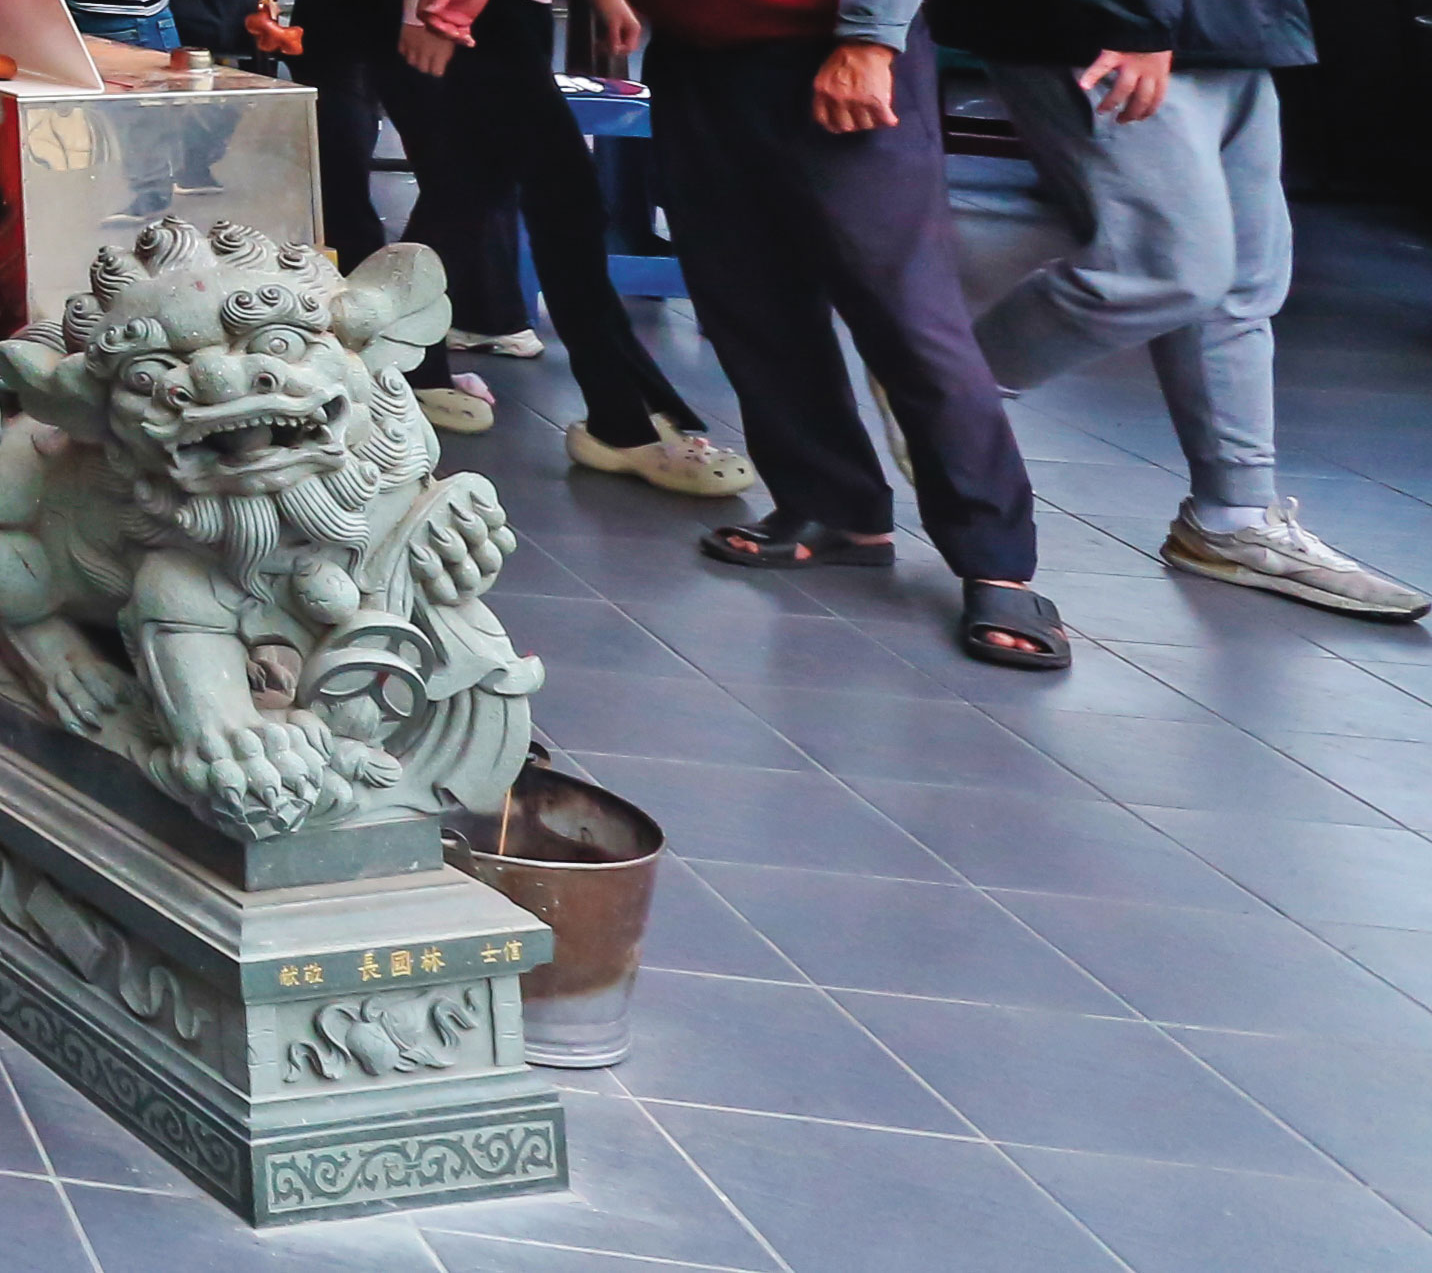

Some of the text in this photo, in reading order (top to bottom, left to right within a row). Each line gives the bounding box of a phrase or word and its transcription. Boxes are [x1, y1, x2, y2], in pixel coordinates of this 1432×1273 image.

[357, 945, 446, 982] 林國長
[481, 939, 523, 964] 信士
